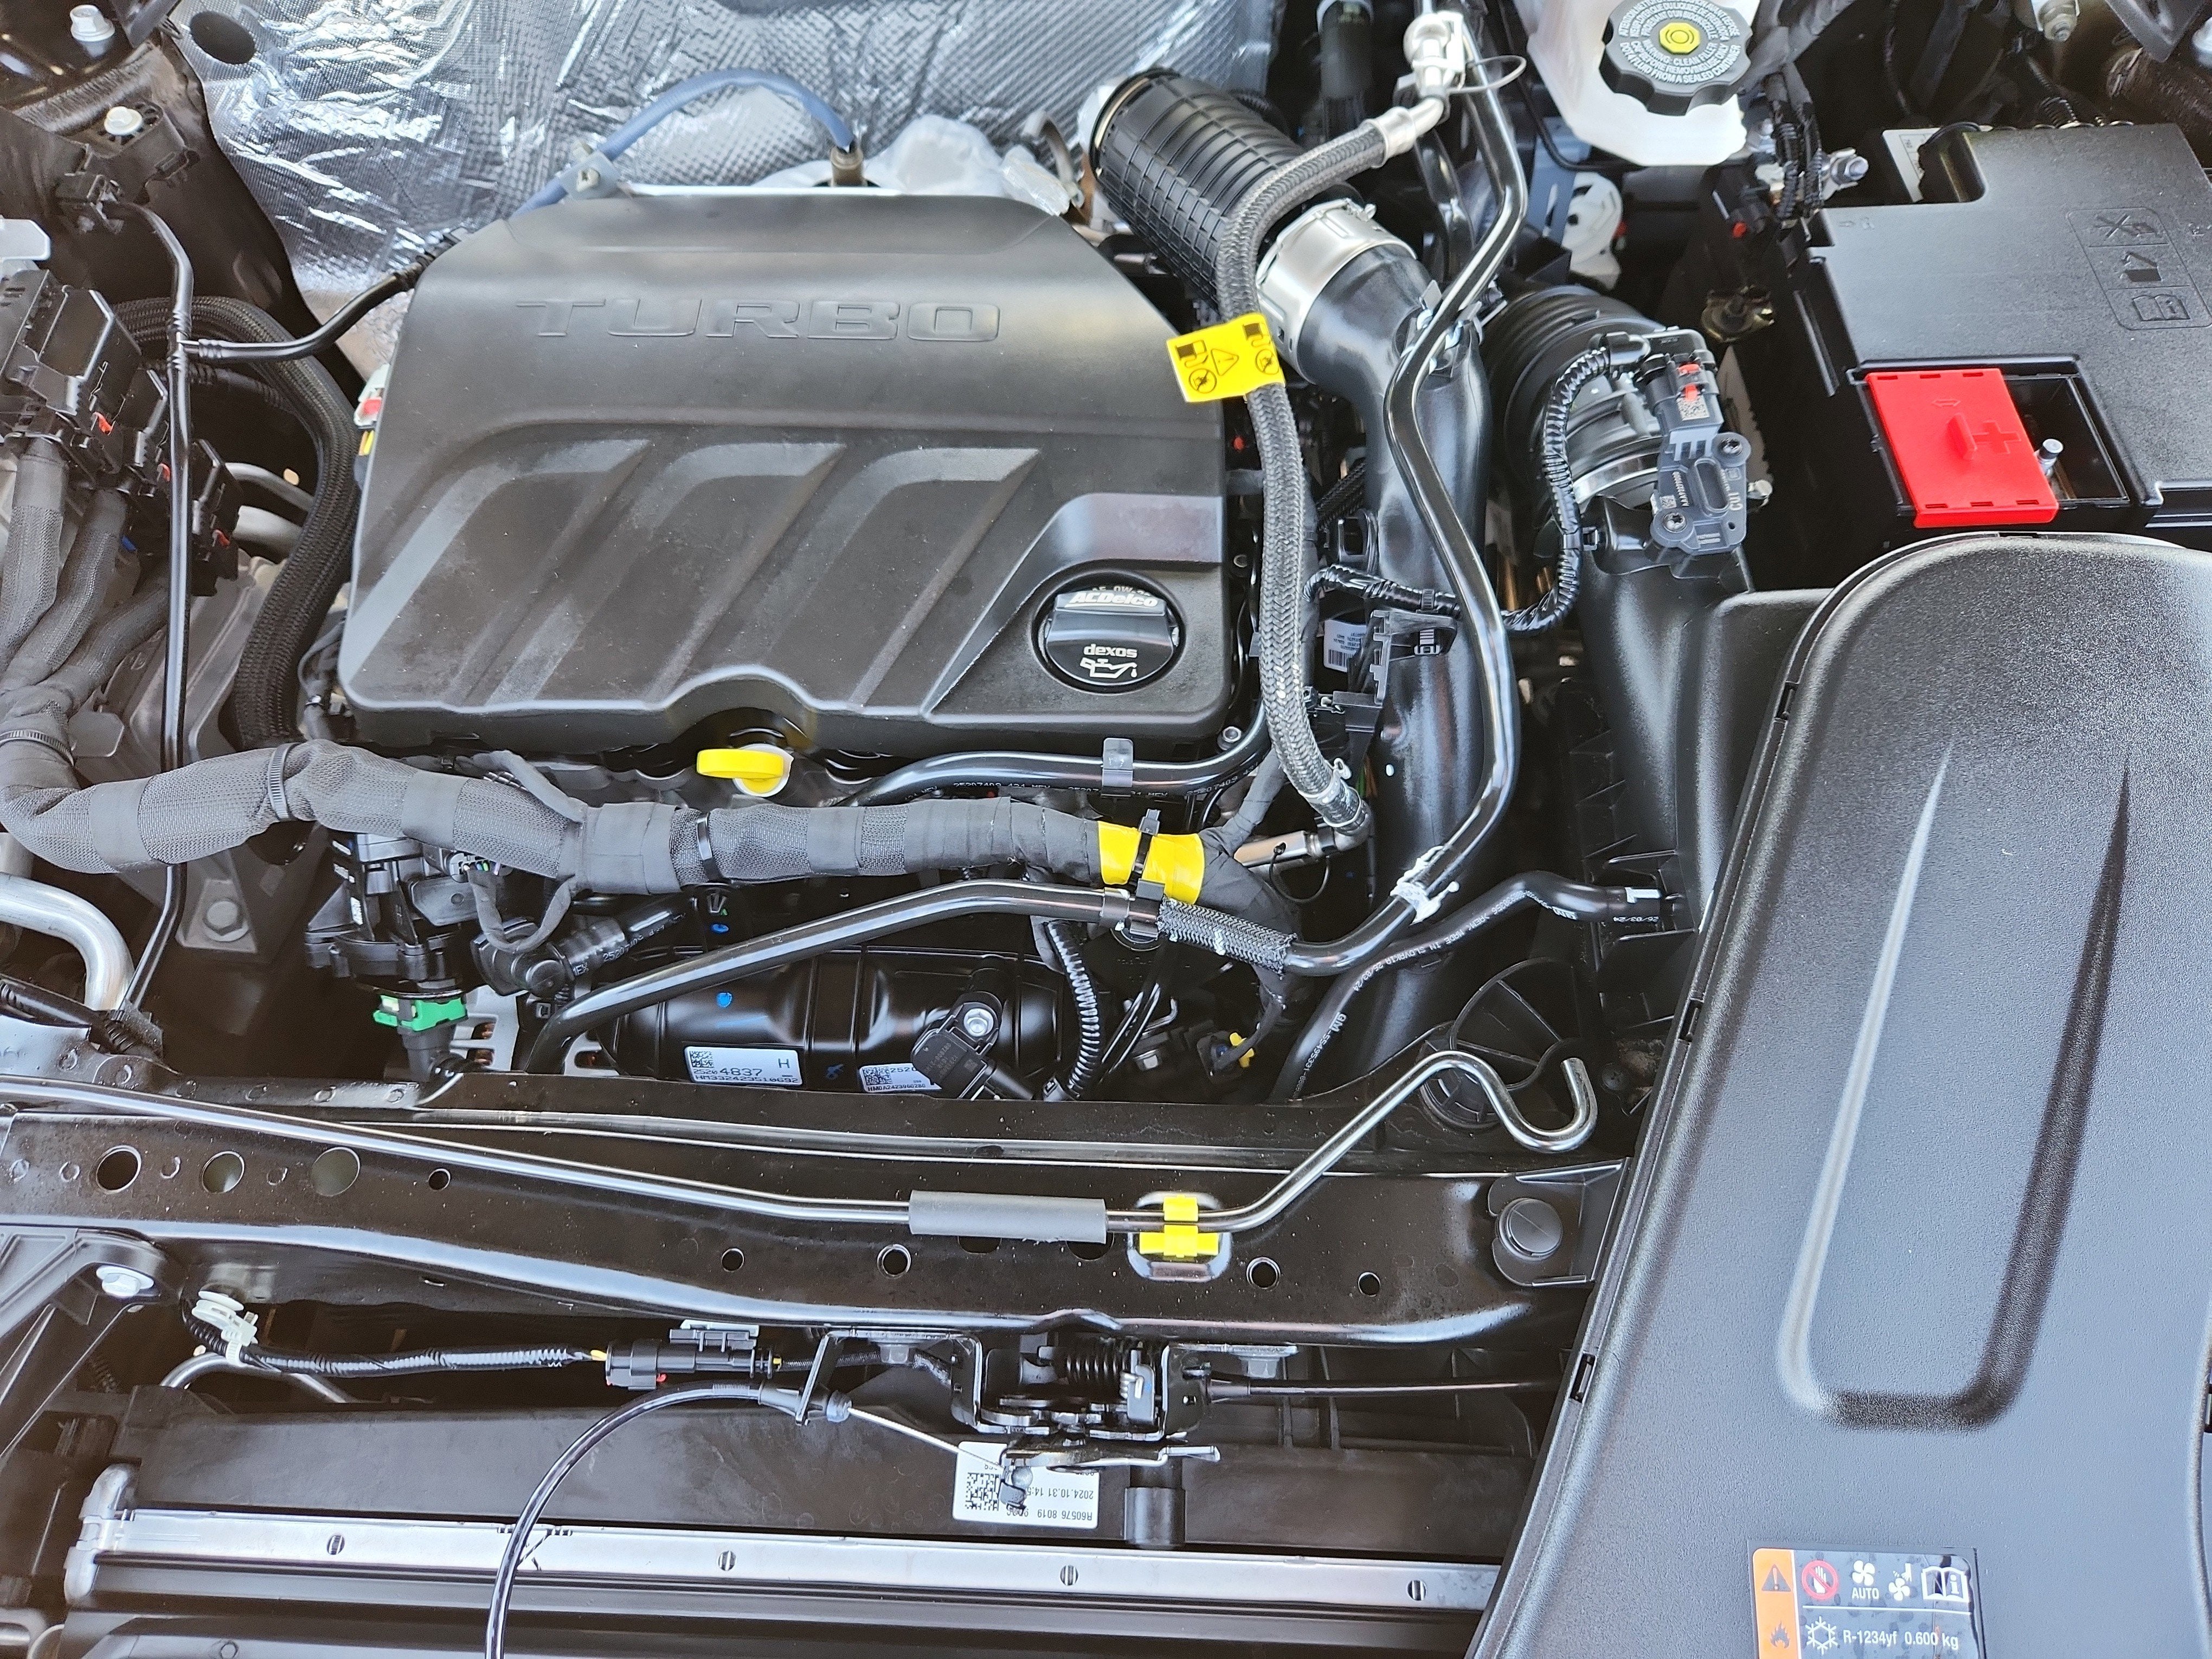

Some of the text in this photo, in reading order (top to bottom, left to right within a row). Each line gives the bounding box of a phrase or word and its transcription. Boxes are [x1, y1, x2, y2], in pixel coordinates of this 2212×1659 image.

[517, 298, 1000, 342] TURBO
[1069, 591, 1158, 607] ACDelco
[1083, 644, 1137, 658] dexos
[1443, 928, 1465, 945] MADE
[1429, 941, 1441, 950] IN
[1385, 947, 1426, 965] SLOVAKIA
[1353, 962, 1384, 992] 26/03/24
[777, 1058, 790, 1069] H
[1026, 1486, 1094, 1500] 2024.10.31 14:5
[1037, 1509, 1057, 1519] 8019
[1060, 1510, 1093, 1521] R60576
[1851, 1587, 1880, 1600] AUTO
[1843, 1629, 1959, 1650] R-1234yf 0.600 kg
